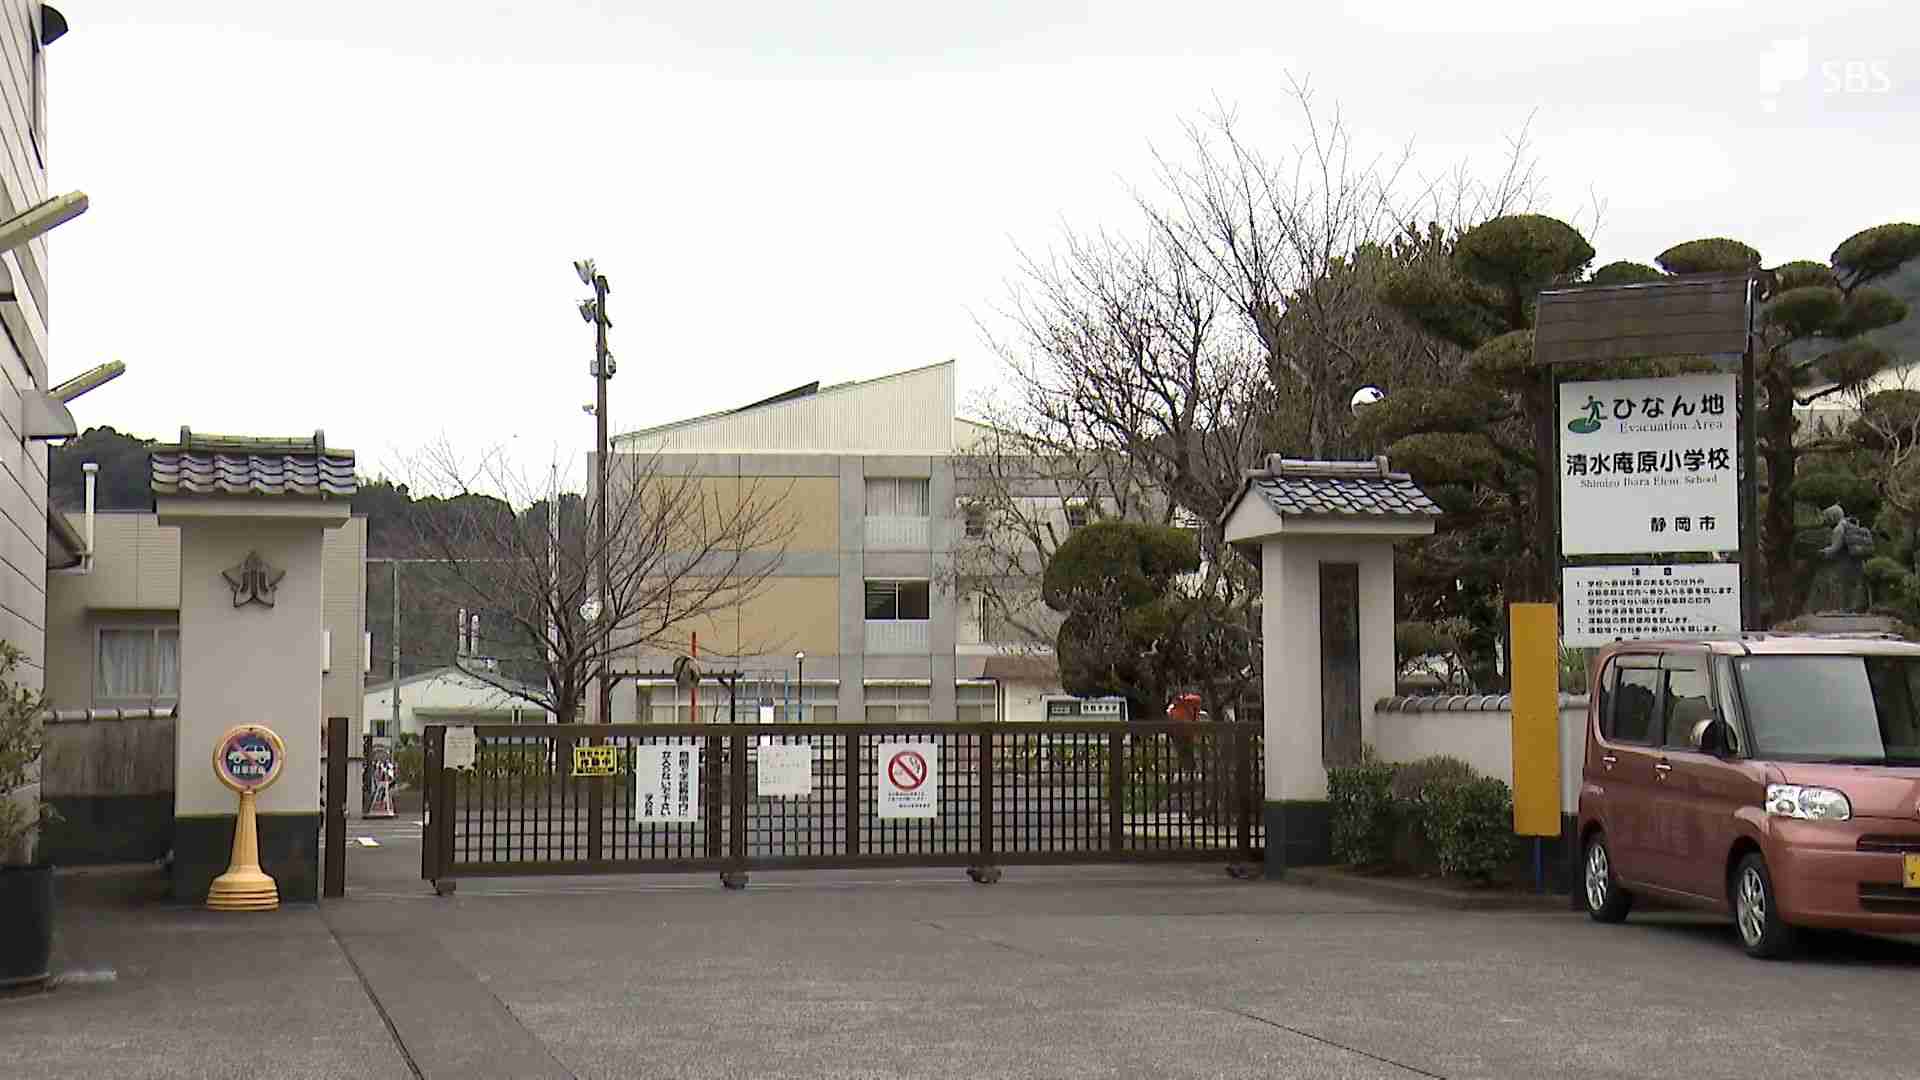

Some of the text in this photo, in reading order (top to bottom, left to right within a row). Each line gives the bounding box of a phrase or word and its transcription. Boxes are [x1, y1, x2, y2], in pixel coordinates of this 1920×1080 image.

[1613, 392, 1724, 419] ひなん地
[1619, 418, 1723, 433] Evacuation Area
[1566, 447, 1730, 476] 清水庵原小学校
[1580, 477, 1620, 488] Shimizu
[1684, 473, 1718, 485] School
[1649, 515, 1716, 533] 静岡市
